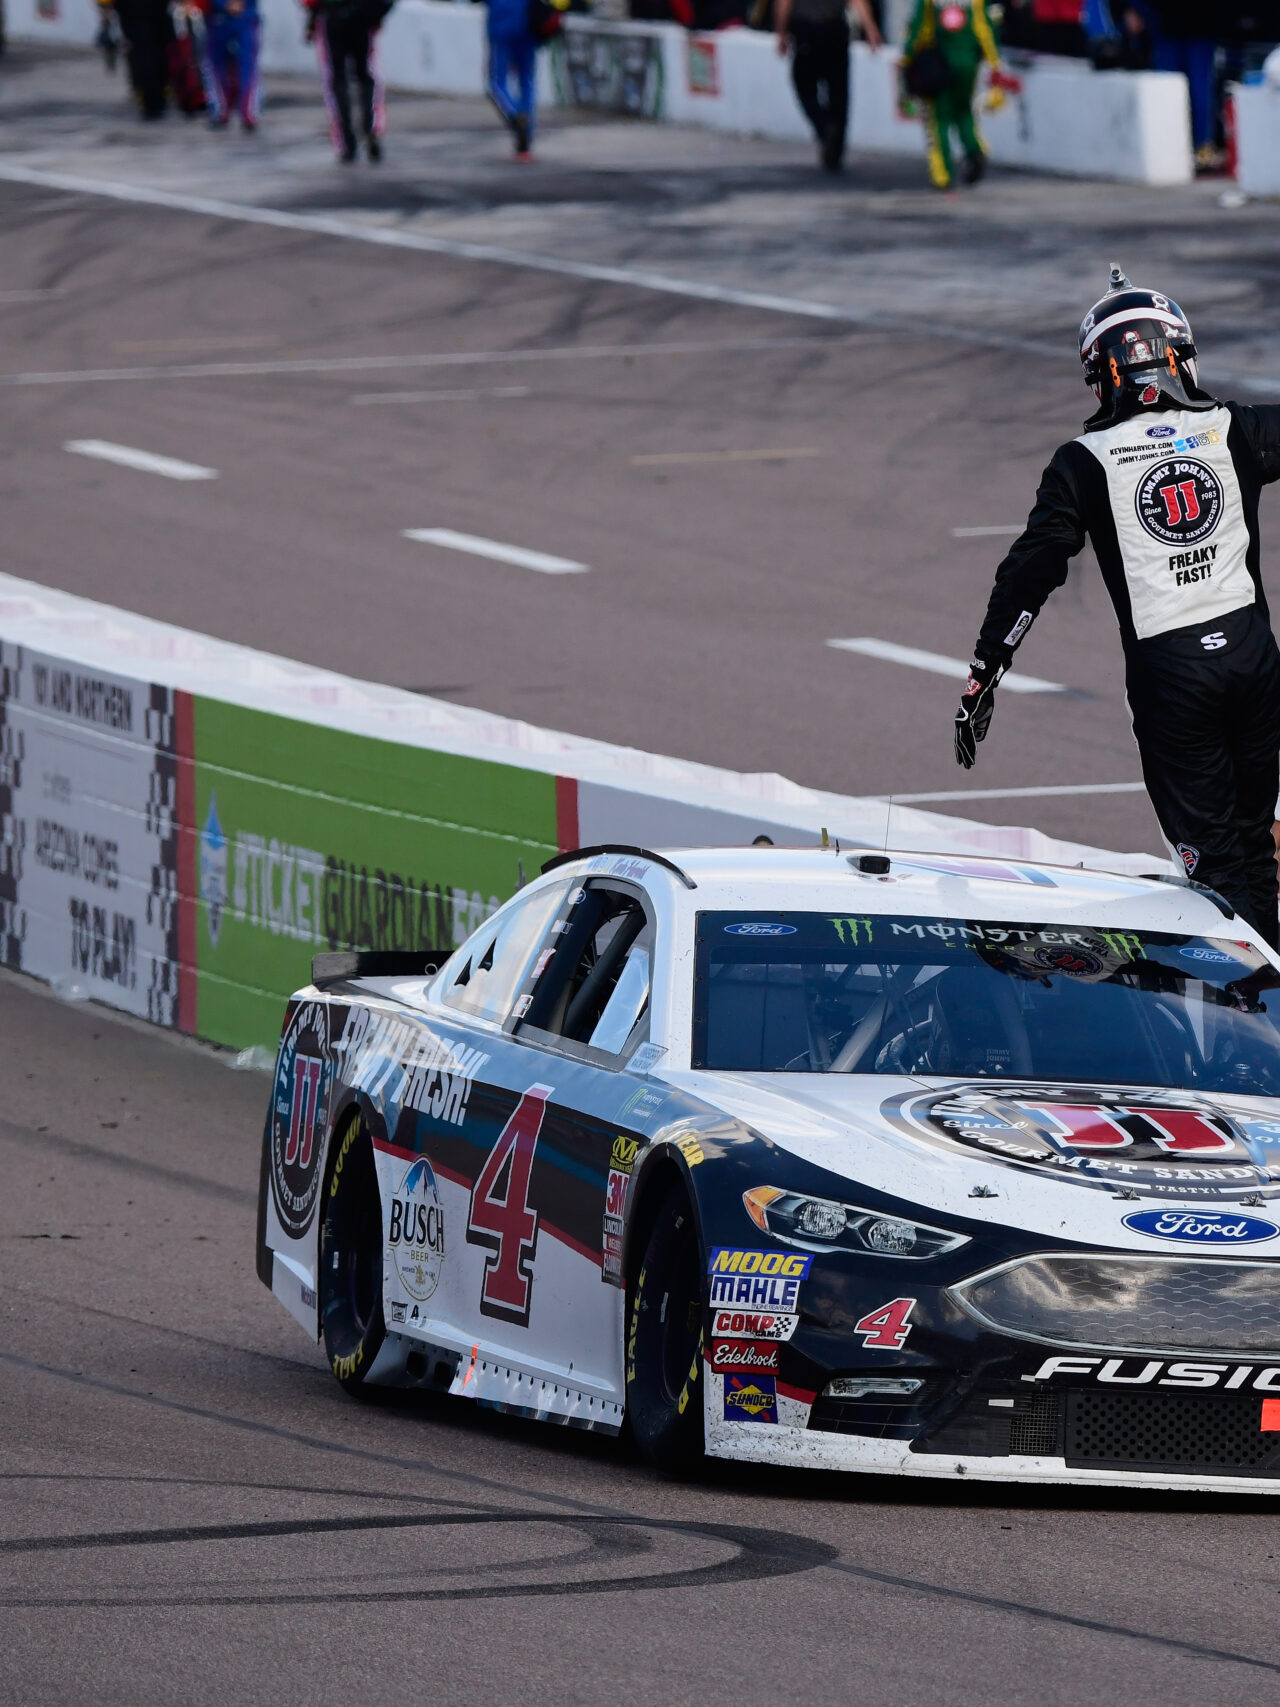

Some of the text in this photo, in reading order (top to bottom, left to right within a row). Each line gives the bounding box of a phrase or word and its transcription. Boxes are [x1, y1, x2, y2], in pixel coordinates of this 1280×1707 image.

[1109, 441, 1173, 456] KEVINHARVICK.COM
[1116, 449, 1175, 466] JIMMYJOHNS.COM
[1142, 466, 1171, 505] JIMMY
[1144, 507, 1162, 516] Since
[1147, 499, 1219, 540] GOURMET SANDWICHES
[1168, 544, 1218, 571] FREAKY
[1175, 565, 1213, 587] FAST!
[890, 922, 1091, 948] MONSTER
[943, 1119, 1029, 1130] Since
[959, 1130, 1138, 1175] GOURMET
[1155, 1184, 1218, 1194] TASTY!
[467, 1082, 556, 1328] 4
[388, 1198, 445, 1254] BUSCH
[410, 1250, 430, 1263] BEER
[712, 1250, 809, 1277] MOOG
[711, 1276, 797, 1306] MAHLE
[717, 1313, 775, 1333] COMP
[755, 1330, 782, 1339] CAMS
[853, 1298, 918, 1350] 4
[713, 1344, 778, 1369] Edelbrock
[728, 1392, 775, 1408] SUNOCO
